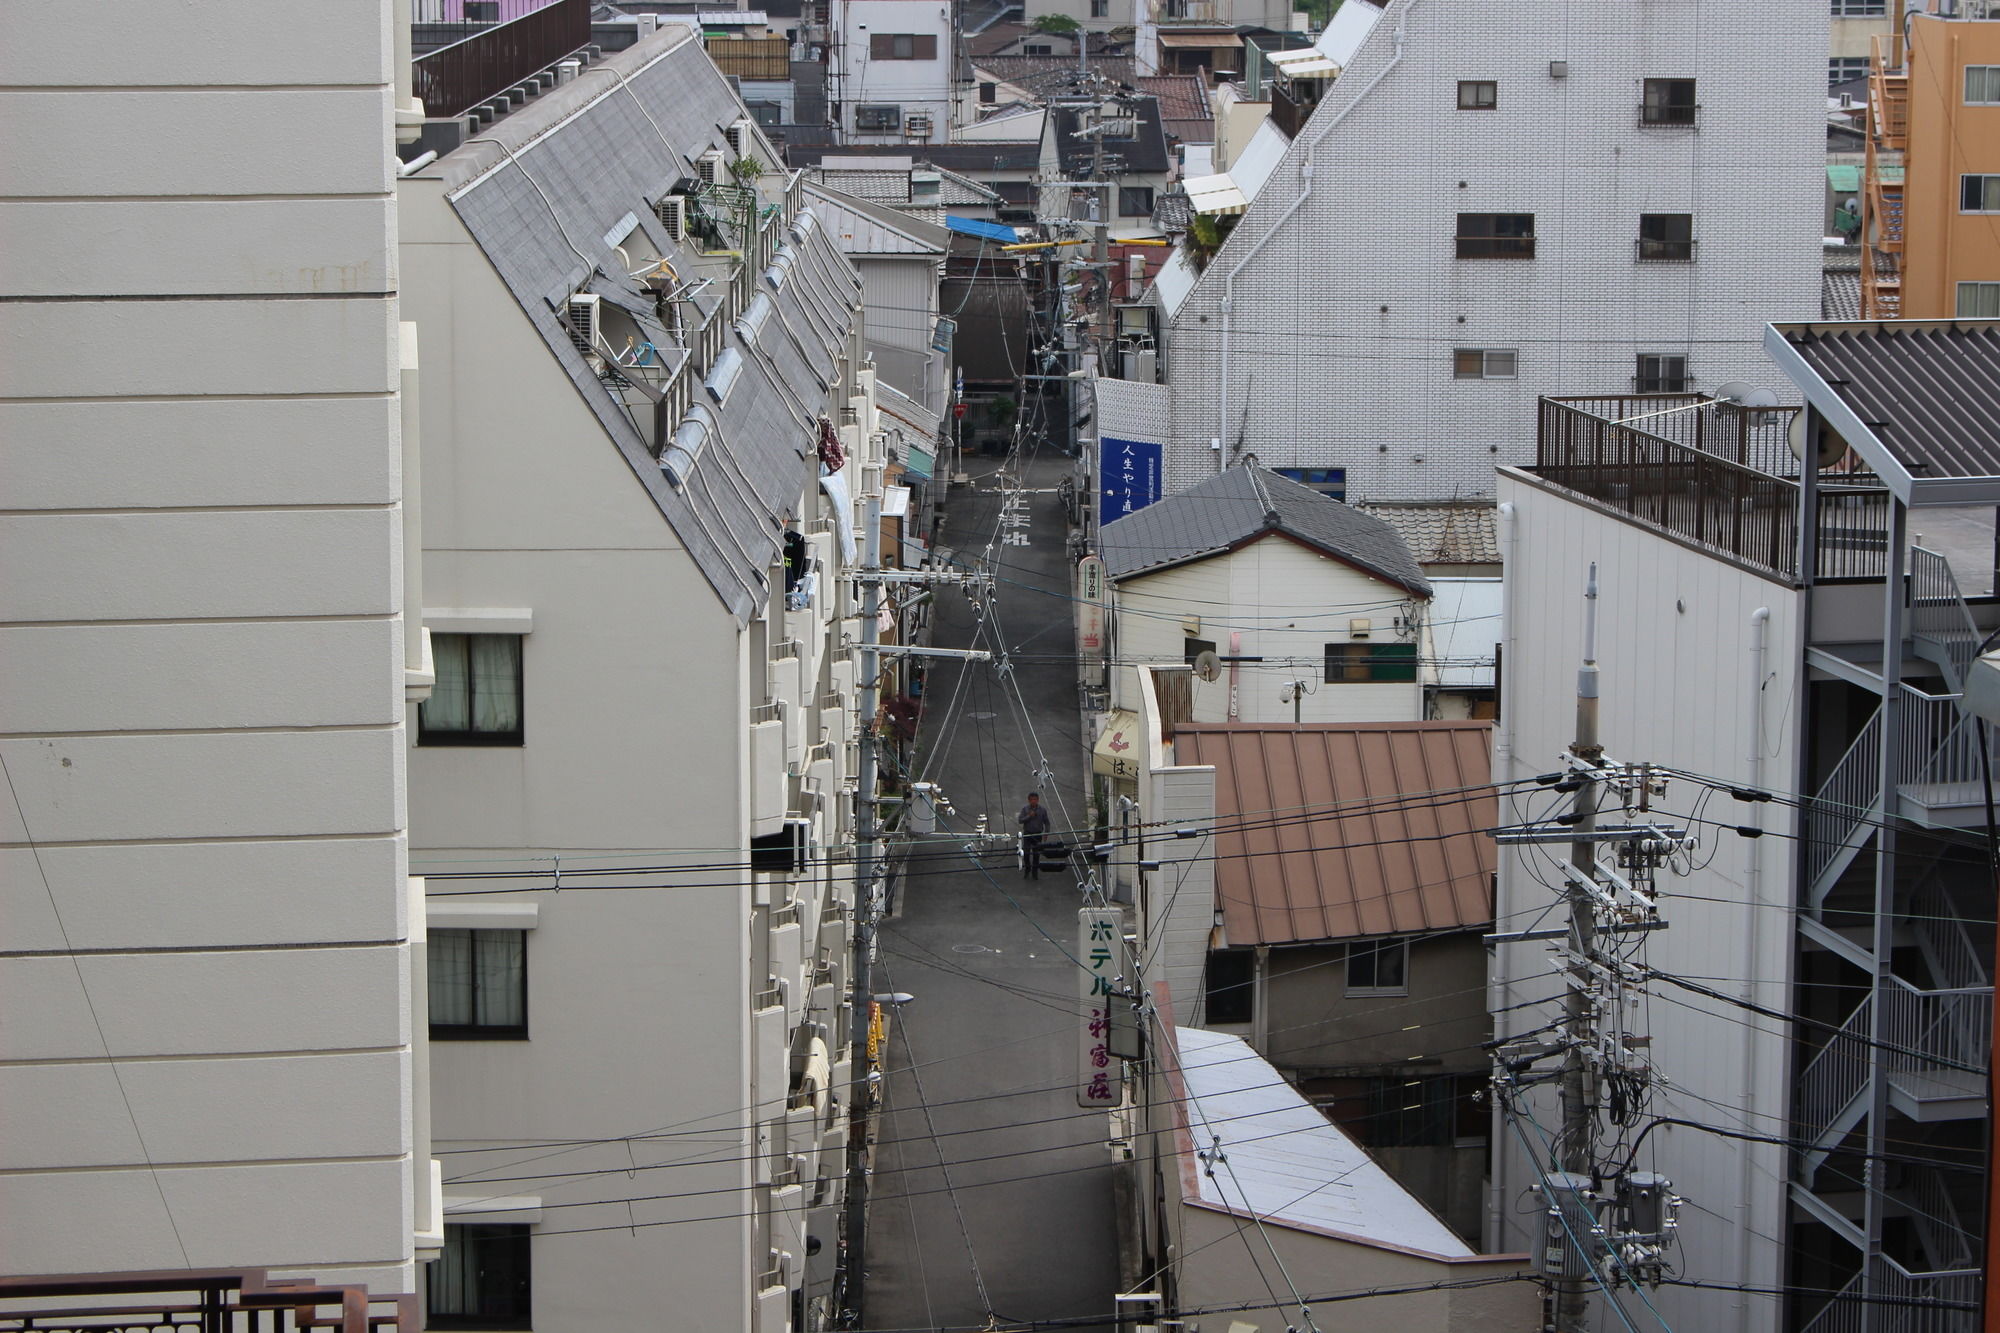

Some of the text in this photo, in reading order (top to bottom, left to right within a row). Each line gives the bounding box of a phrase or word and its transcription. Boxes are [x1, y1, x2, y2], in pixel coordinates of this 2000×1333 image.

[1002, 496, 1030, 546] 止まれ
[1089, 920, 1112, 996] ホテル
